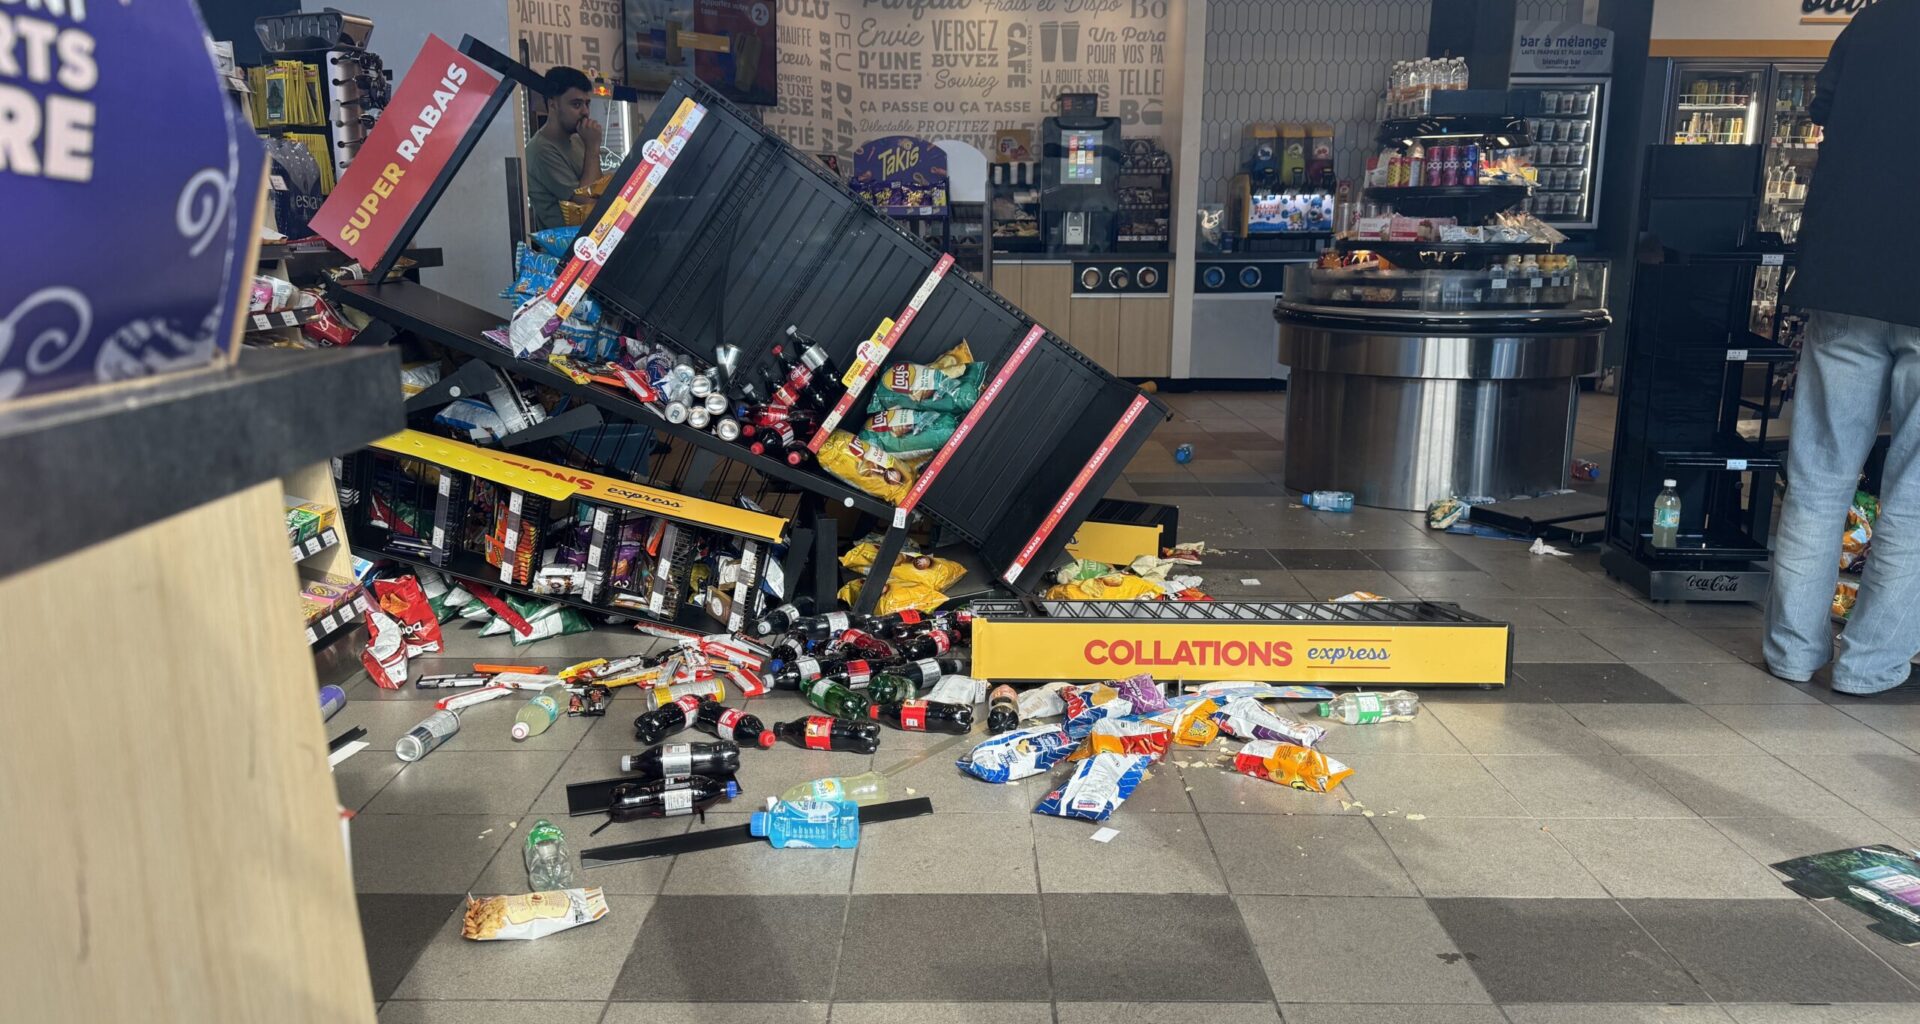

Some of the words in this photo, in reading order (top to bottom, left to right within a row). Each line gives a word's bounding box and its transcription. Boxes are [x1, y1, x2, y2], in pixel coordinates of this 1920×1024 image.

[834, 12, 851, 71] PEU
[857, 17, 924, 48] Envie
[931, 19, 998, 52] VERSEZ
[1089, 27, 1118, 43] Un
[1520, 35, 1540, 47] bar
[1544, 35, 1552, 47] à
[1556, 35, 1607, 49] mélange
[820, 31, 831, 72] BYE
[858, 51, 922, 70] D'UNE
[931, 53, 999, 67] BUVEZ
[1087, 45, 1115, 64] POUR
[1123, 45, 1144, 64] VOS
[858, 73, 922, 90] TASSE?
[934, 69, 1000, 97] Souriez
[1041, 70, 1050, 83] LA
[1056, 70, 1082, 83] ROUTE
[1087, 70, 1110, 83] SERA
[787, 84, 814, 97] UNE
[821, 80, 833, 120] BYE
[859, 102, 876, 115] ÇA
[882, 102, 928, 112] PASSE
[933, 102, 955, 112] OU
[960, 102, 981, 115] ÇA
[985, 102, 1031, 112] TASSE
[917, 120, 989, 132] PROFITEZ
[340, 162, 406, 246] SUPER
[396, 62, 468, 162] RABAIS
[878, 146, 920, 181] Takis
[893, 308, 915, 333] RABAIS
[1018, 330, 1039, 355] RABAIS
[890, 364, 912, 391] Lay's
[983, 377, 1004, 401] RABAIS
[1122, 400, 1143, 424] RABAIS
[949, 423, 969, 447] RABAIS
[1088, 445, 1108, 469] RABAIS
[915, 468, 935, 492] RABAIS
[607, 486, 683, 508] express
[1055, 490, 1075, 514] RABAIS
[1021, 535, 1041, 558] RABAIS
[1084, 639, 1293, 667] COLLATIONS
[1307, 646, 1391, 664] express
